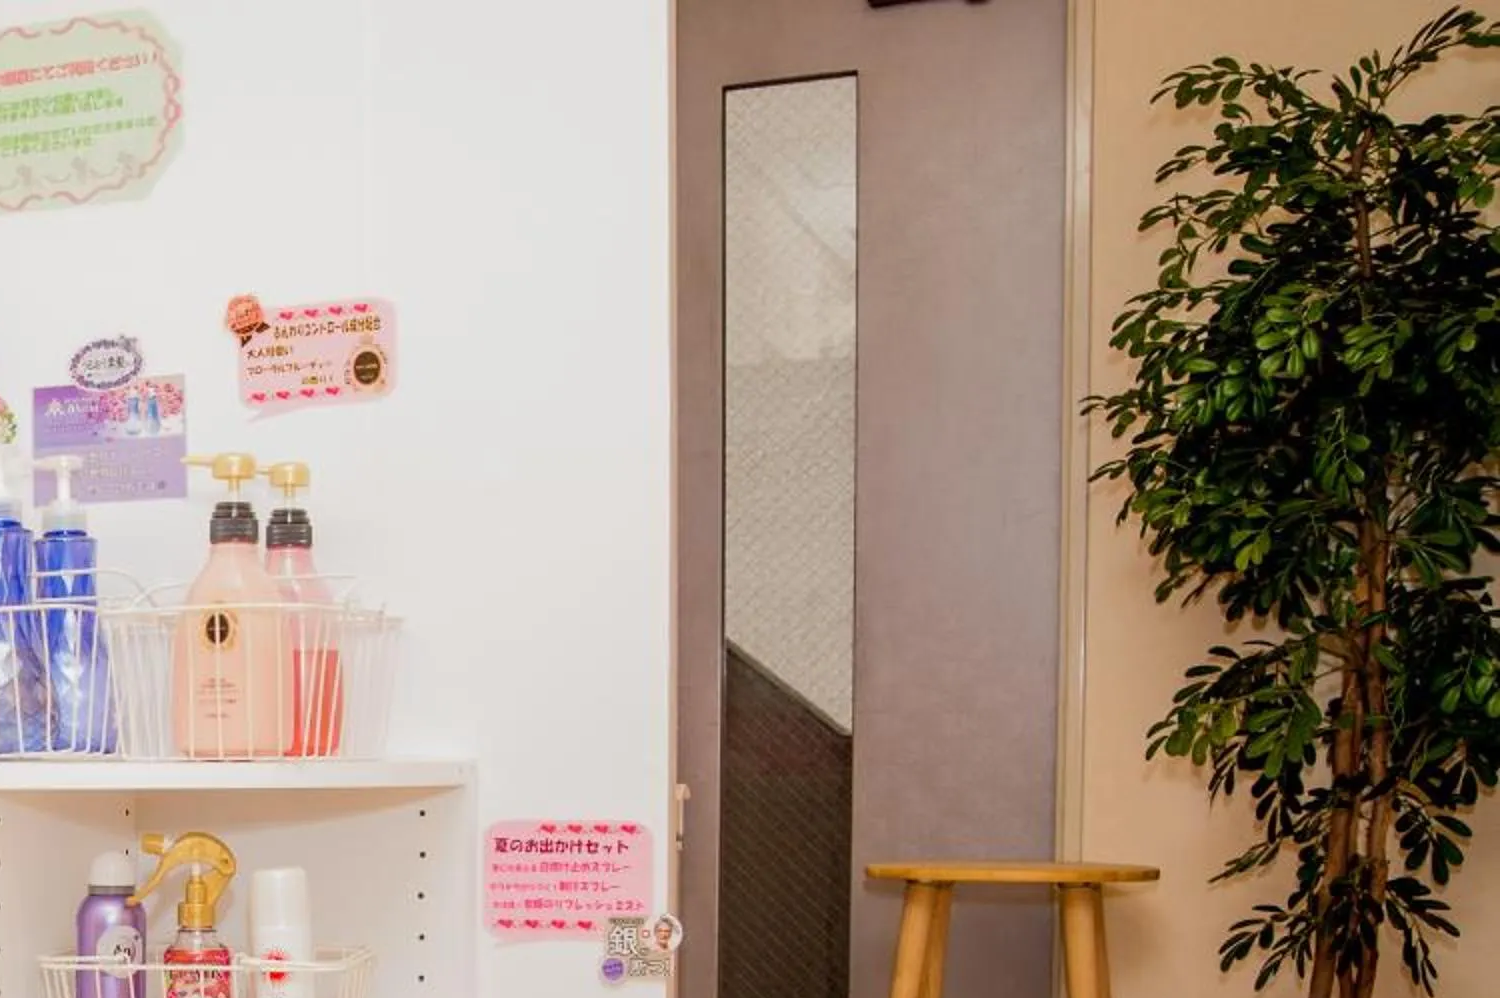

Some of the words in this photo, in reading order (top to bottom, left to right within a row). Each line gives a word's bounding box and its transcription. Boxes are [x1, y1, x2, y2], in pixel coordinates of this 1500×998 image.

[493, 837, 630, 855] 夏のお出かけセット
